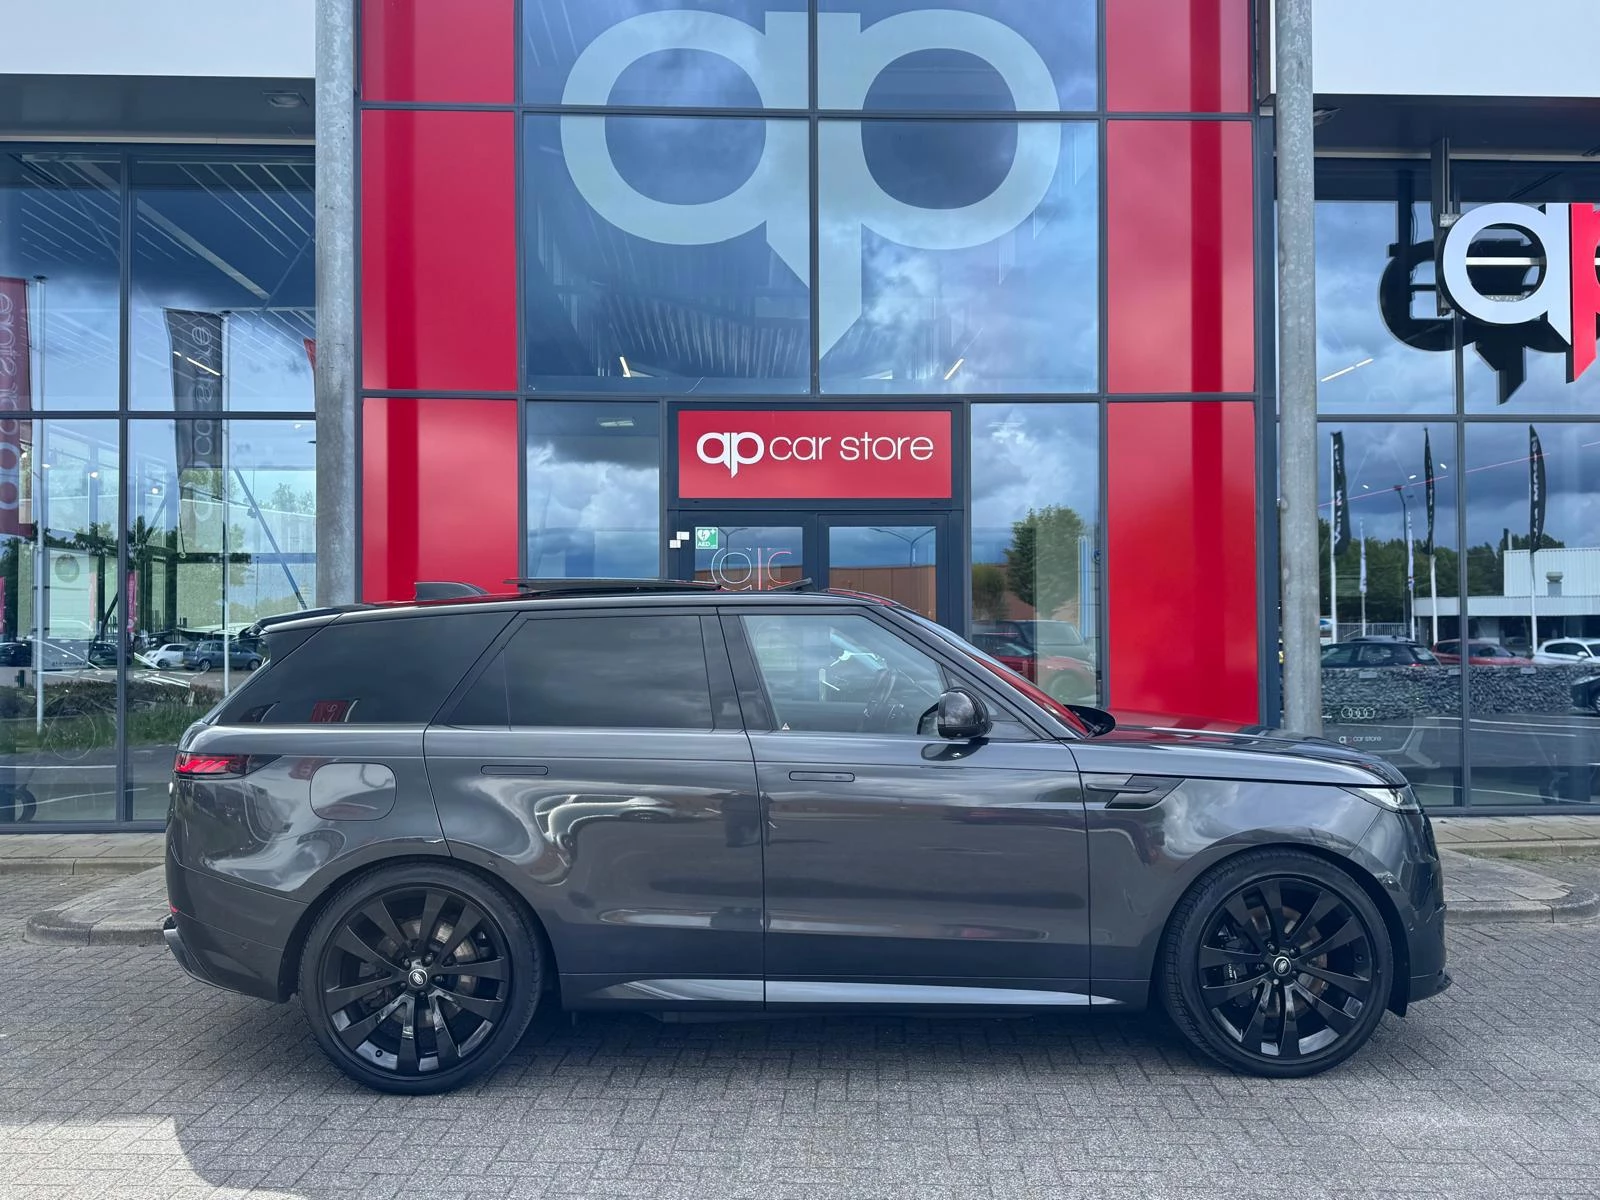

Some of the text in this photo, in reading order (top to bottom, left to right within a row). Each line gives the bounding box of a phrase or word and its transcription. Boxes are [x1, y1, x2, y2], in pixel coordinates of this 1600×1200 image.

[560, 9, 1061, 361] ap
[696, 431, 934, 479] ap car store
